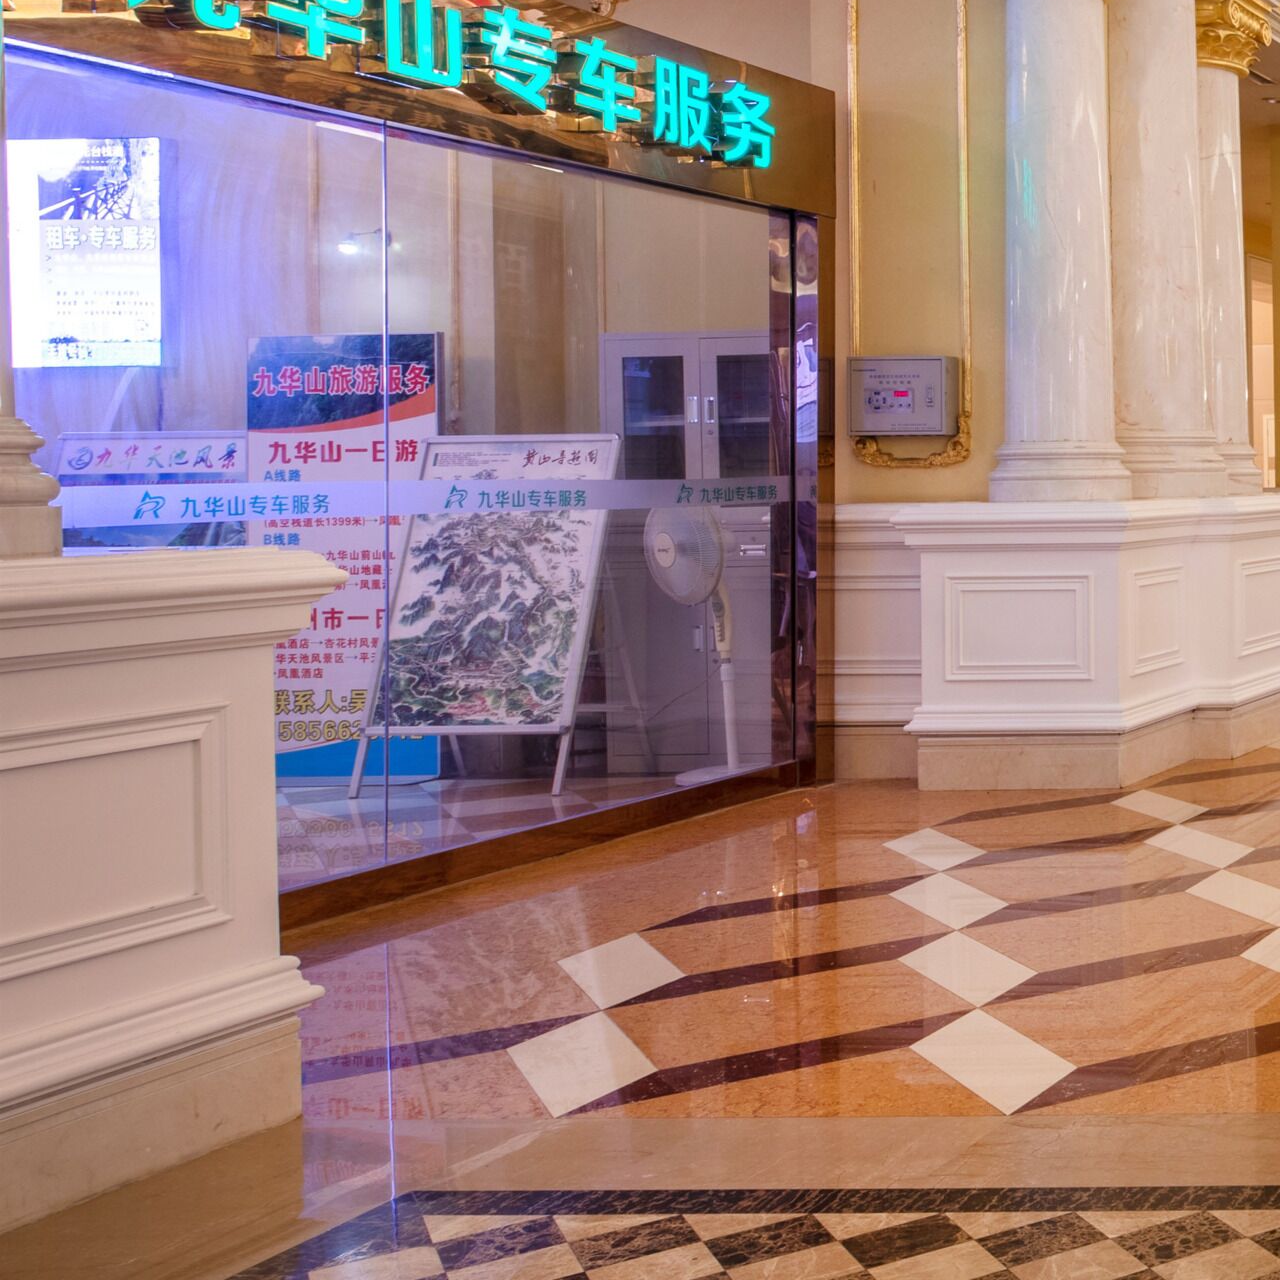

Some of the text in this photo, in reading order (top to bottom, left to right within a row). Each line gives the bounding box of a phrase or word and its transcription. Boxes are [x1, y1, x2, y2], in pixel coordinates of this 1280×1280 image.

[253, 363, 429, 398] 九华山旅游服务
[268, 439, 419, 465] 九华山一日游
[264, 469, 301, 482] A线路
[478, 489, 588, 509] 九华山专车服务
[701, 484, 778, 504] 九华山专车服务
[180, 493, 330, 519] 九华山专车服务
[263, 532, 301, 546] B线路
[277, 668, 324, 680] 凤凰酒店
